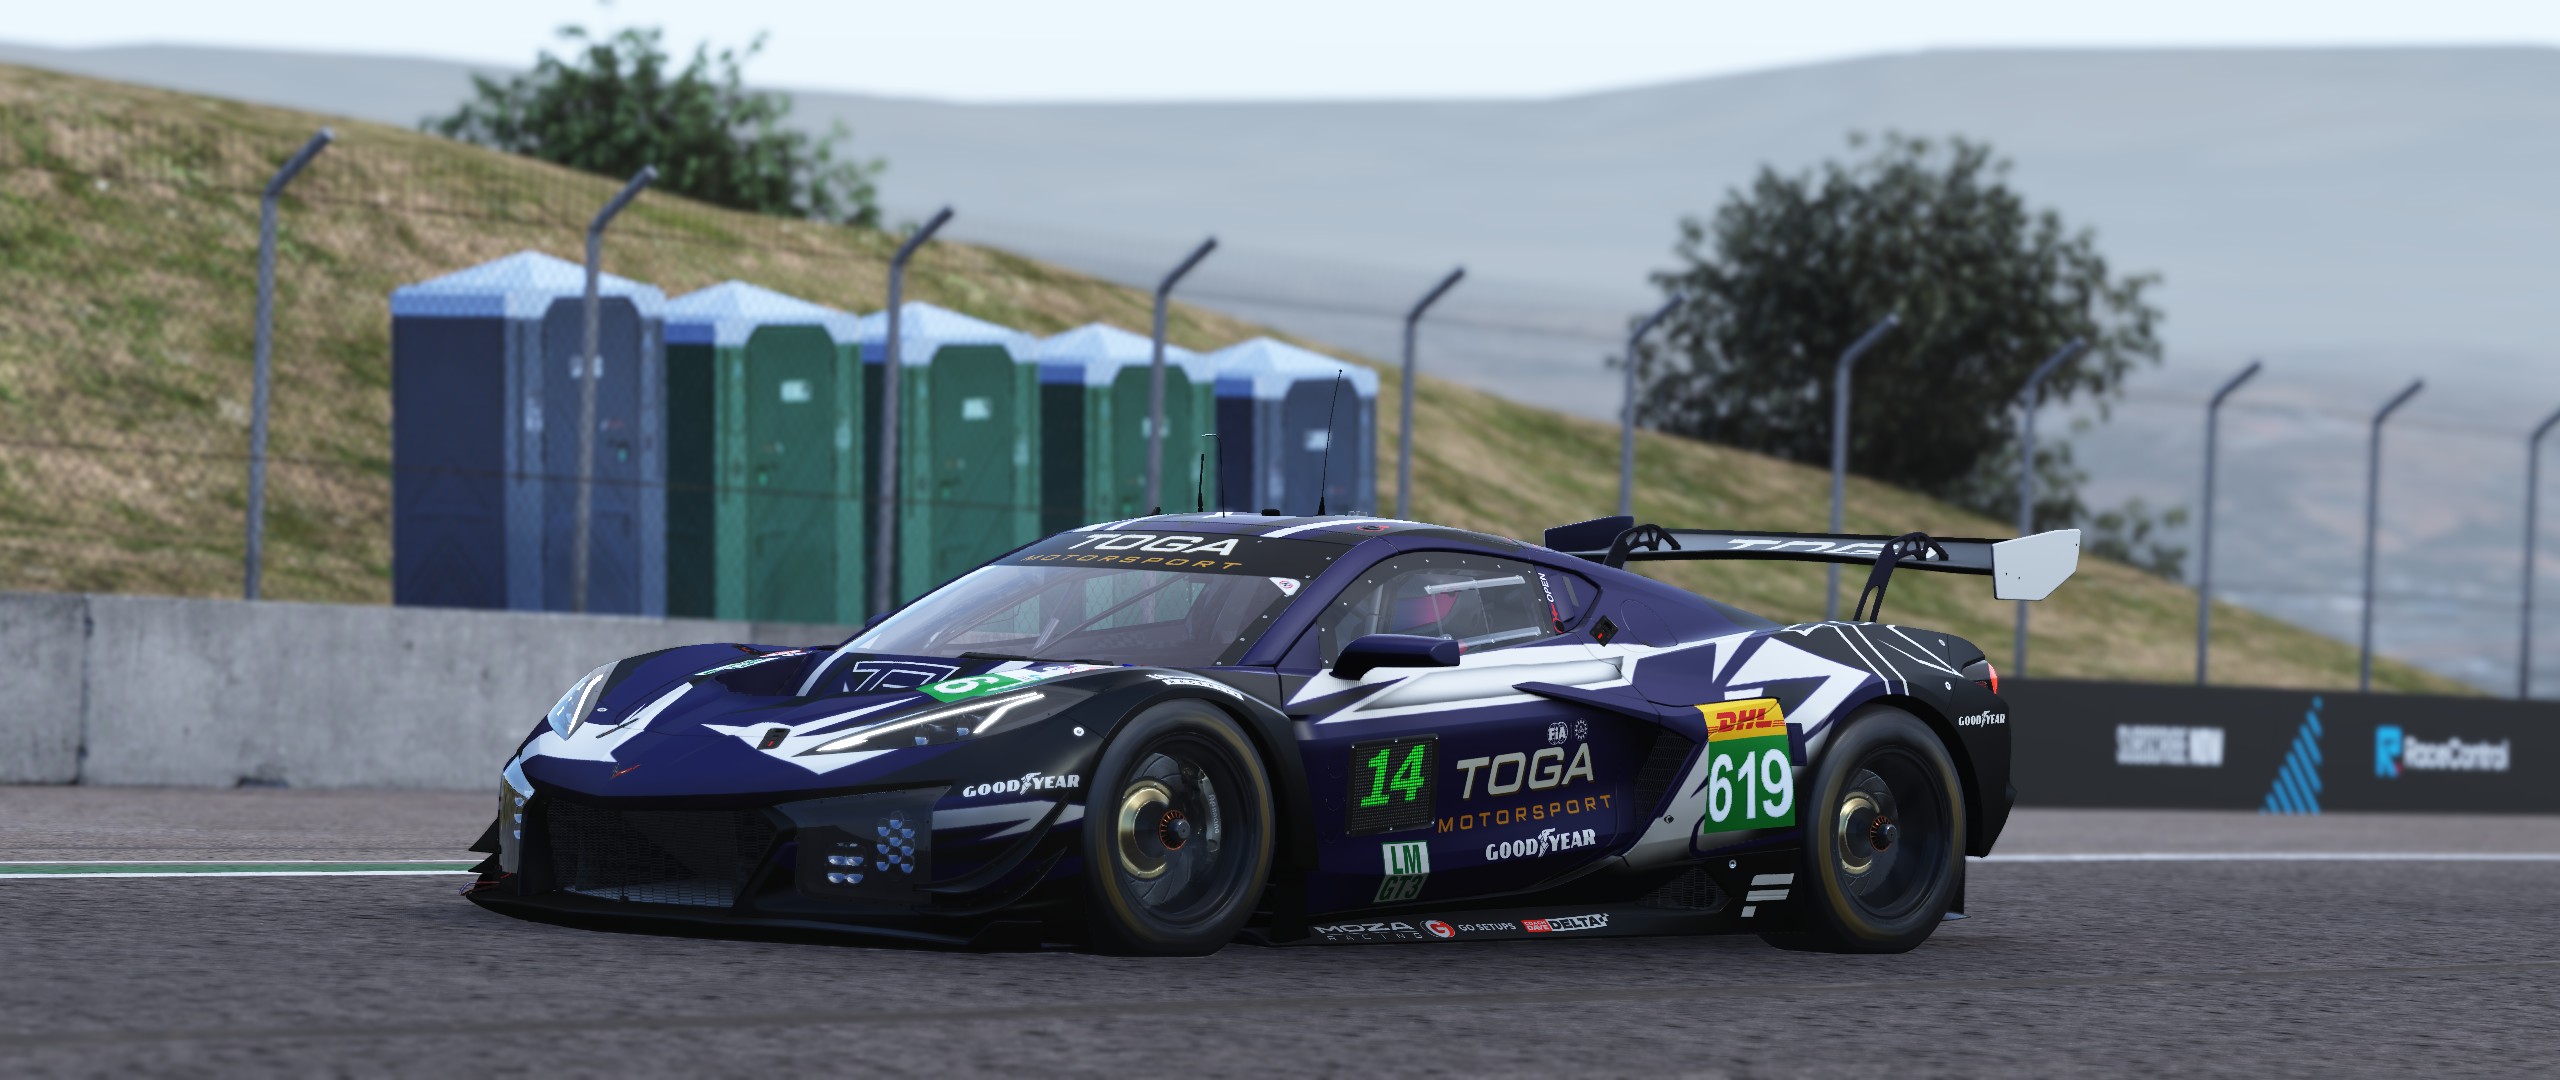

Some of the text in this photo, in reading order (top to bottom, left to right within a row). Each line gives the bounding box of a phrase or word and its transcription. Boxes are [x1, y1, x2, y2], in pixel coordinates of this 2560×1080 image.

[1067, 534, 1239, 556] TOGA
[1020, 554, 1243, 570] MOTORSPORT
[1537, 572, 1555, 603] OPEN
[1715, 708, 1773, 733] DHL
[962, 771, 1080, 798] GOODYEAR
[1361, 744, 1426, 808] 14
[1456, 743, 1595, 801] TOGA
[1708, 748, 1794, 823] 619
[1438, 794, 1611, 834] MOTORSPORT
[1485, 827, 1596, 861] GOODYEAR
[1390, 844, 1422, 875] LM
[1379, 875, 1425, 901] GT3
[1313, 921, 1415, 934] MOZA
[1458, 922, 1517, 932] GO SETUPS
[1549, 915, 1602, 931] DELTA
[1326, 932, 1423, 941] RACING
